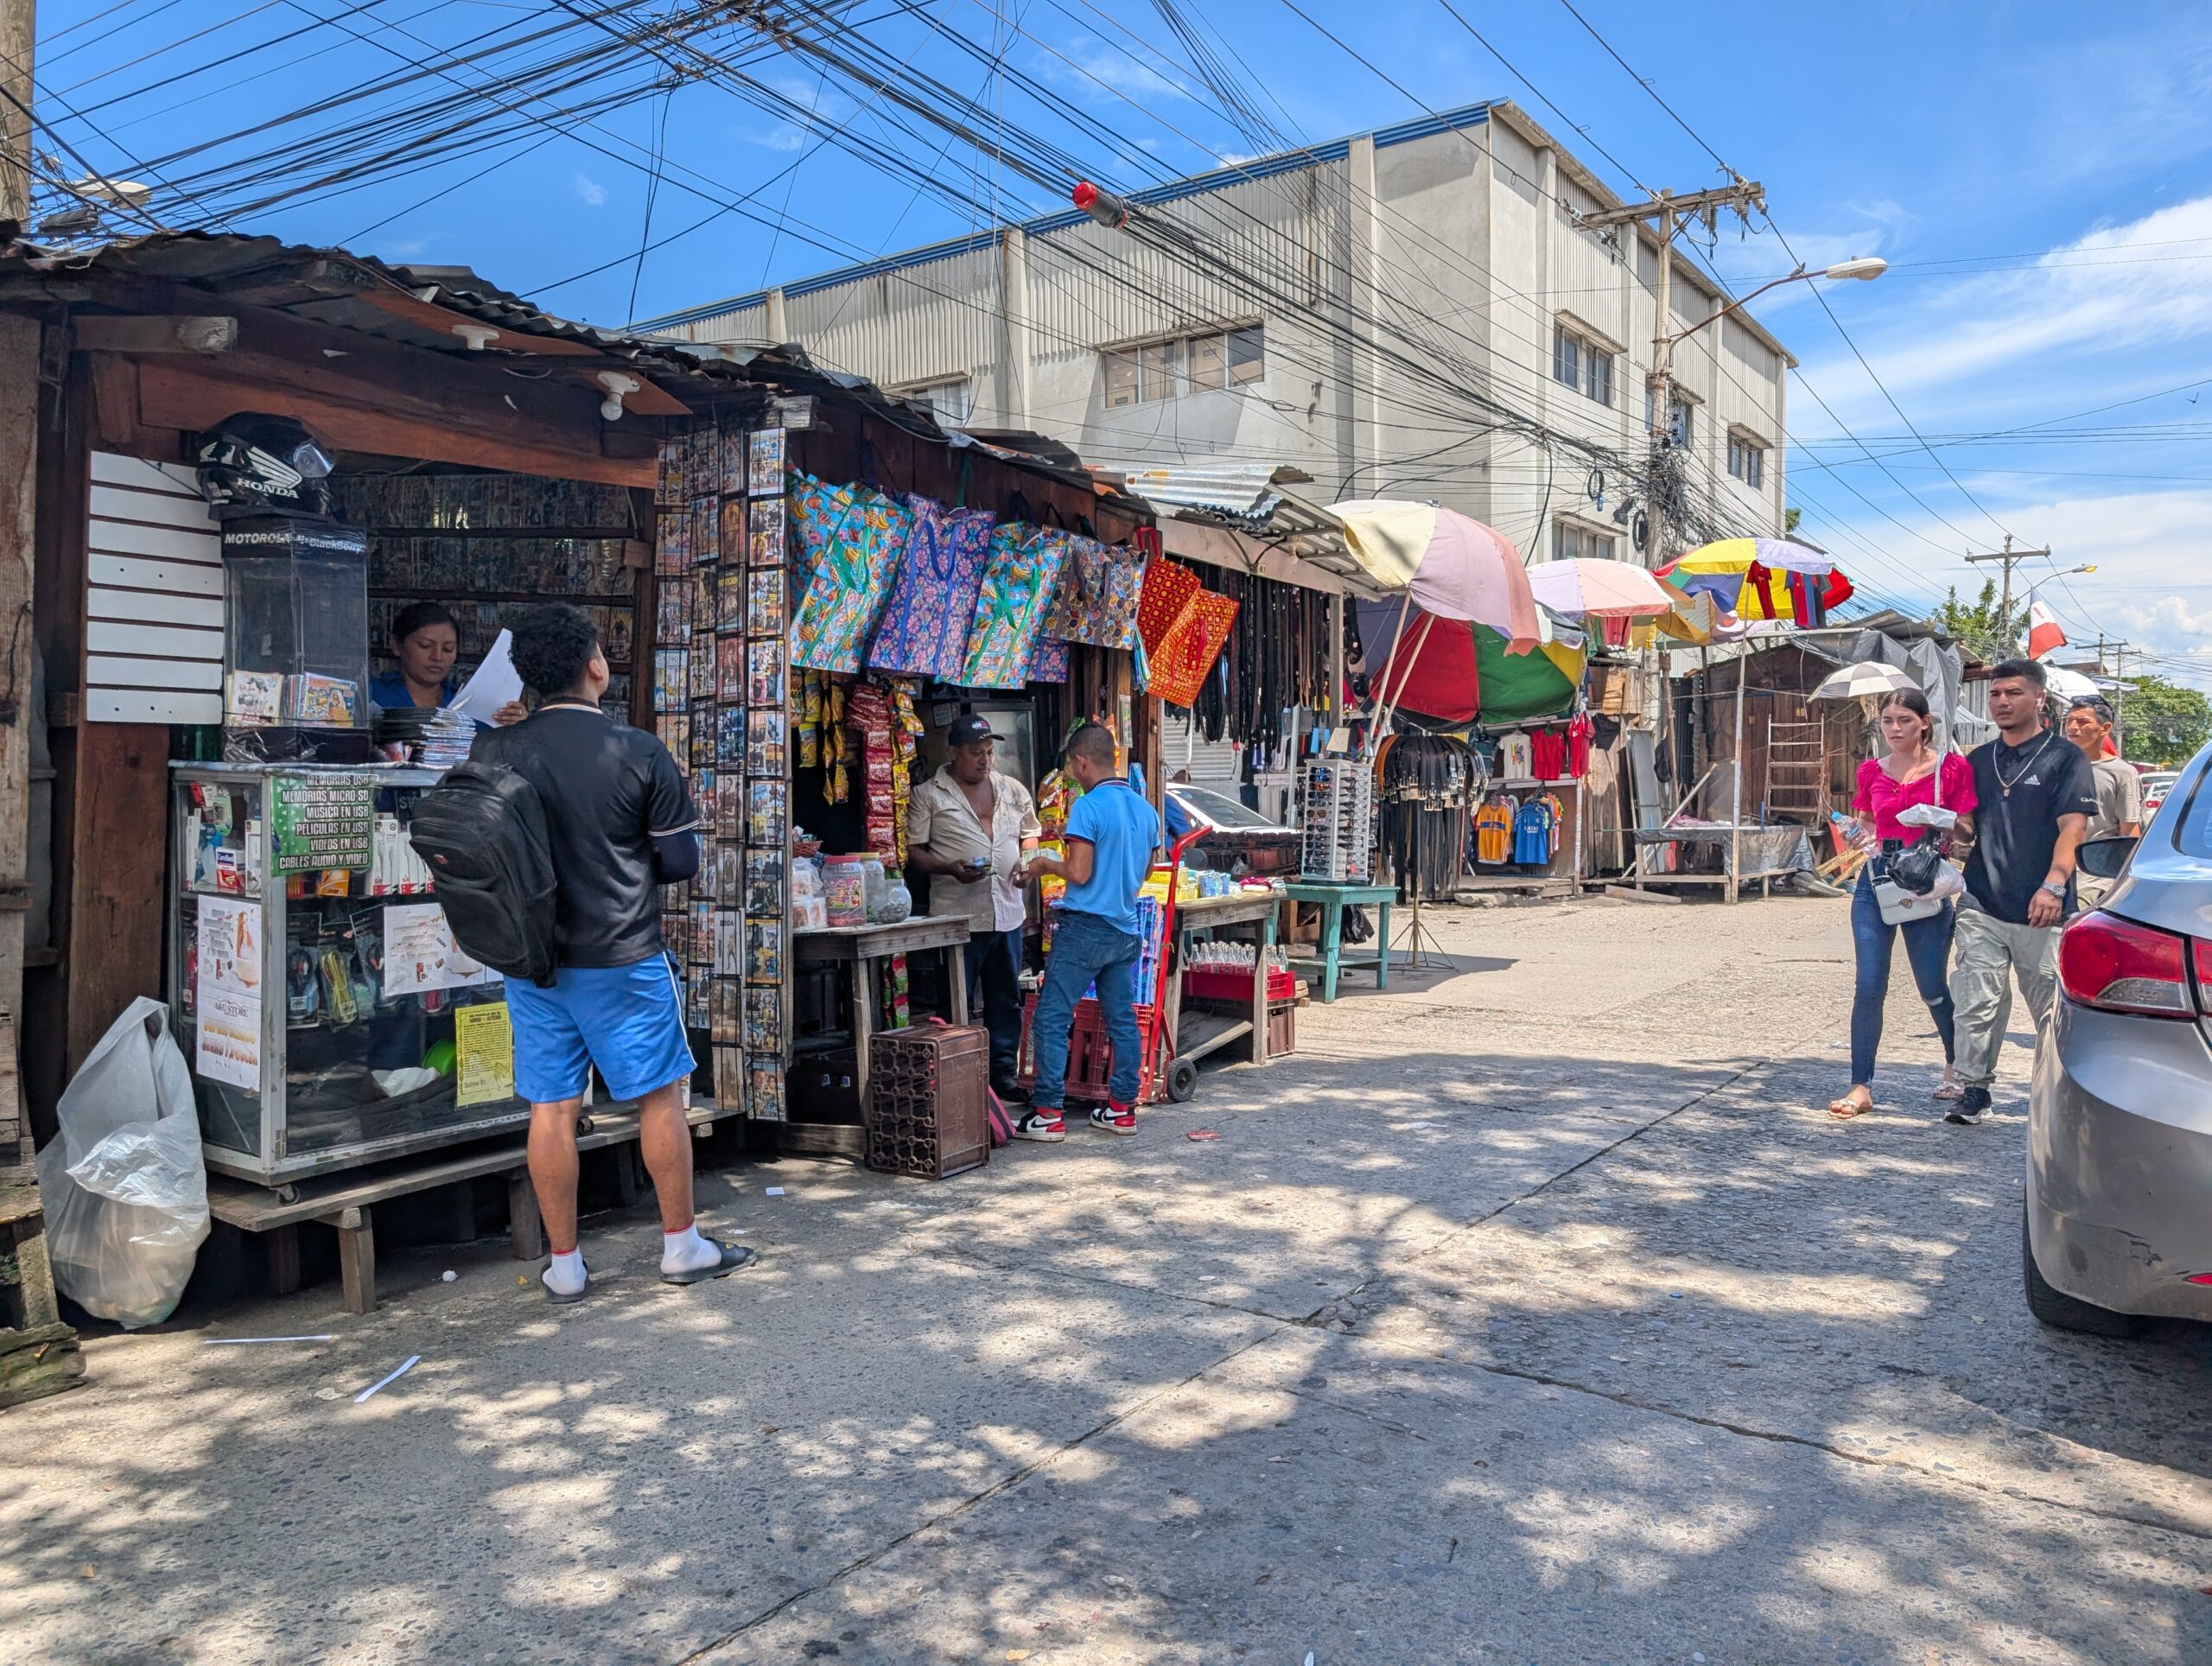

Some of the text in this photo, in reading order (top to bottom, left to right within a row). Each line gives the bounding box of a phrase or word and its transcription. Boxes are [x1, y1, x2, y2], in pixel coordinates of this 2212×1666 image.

[236, 477, 300, 499] HONDA
[225, 533, 291, 544] MOTOROLA
[309, 537, 365, 554] BlackBerry
[307, 774, 352, 786] MEMORIAS
[282, 790, 369, 803] MEMORIAS MICRO SD
[307, 805, 369, 818] MUSICA EN USB
[296, 821, 369, 836] PELICULAS EN USB
[310, 836, 368, 851] VIDEOS EN USB
[279, 852, 368, 869] CABLES AUDIO Y VIDEO
[227, 1006, 249, 1018] STORE
